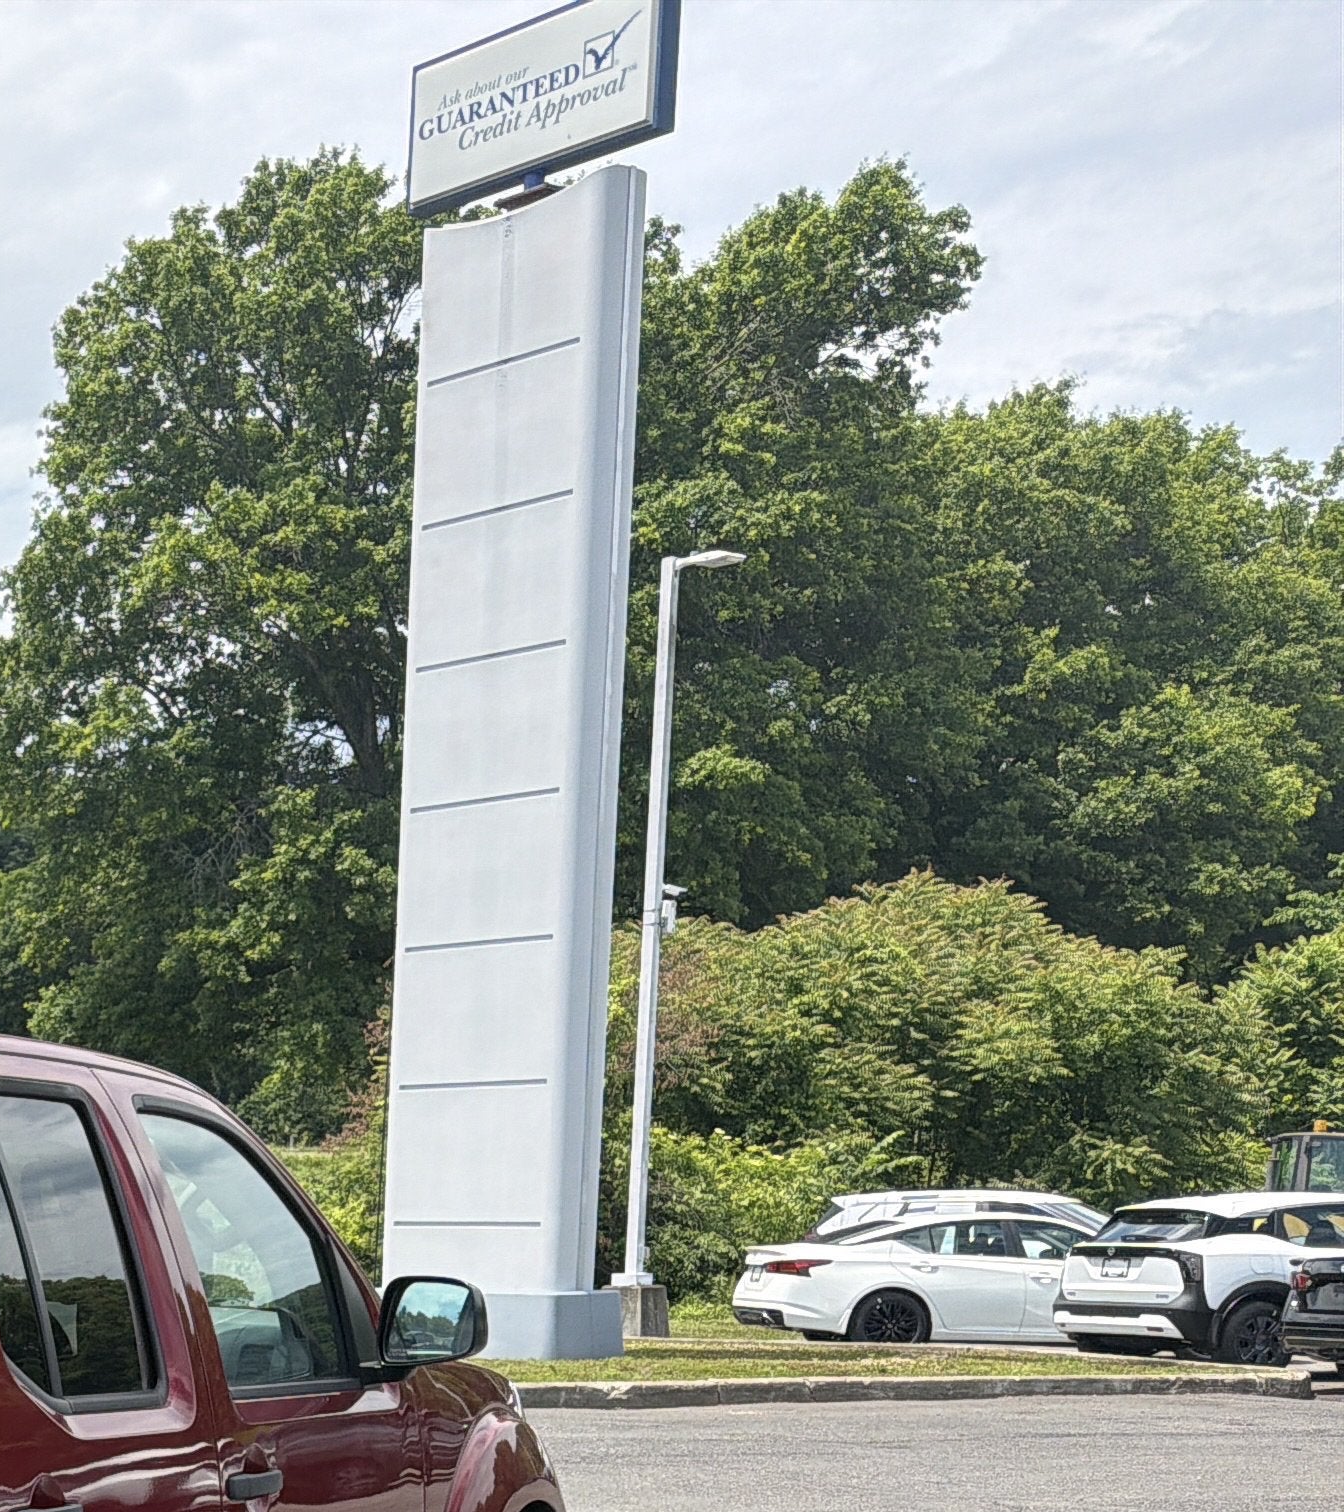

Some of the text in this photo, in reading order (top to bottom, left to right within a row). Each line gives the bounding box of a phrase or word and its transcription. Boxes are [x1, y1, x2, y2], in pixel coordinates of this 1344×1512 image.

[418, 63, 581, 141] GUARANTEED
[438, 66, 530, 111] Ask about our
[458, 67, 628, 151] Credit Approval
